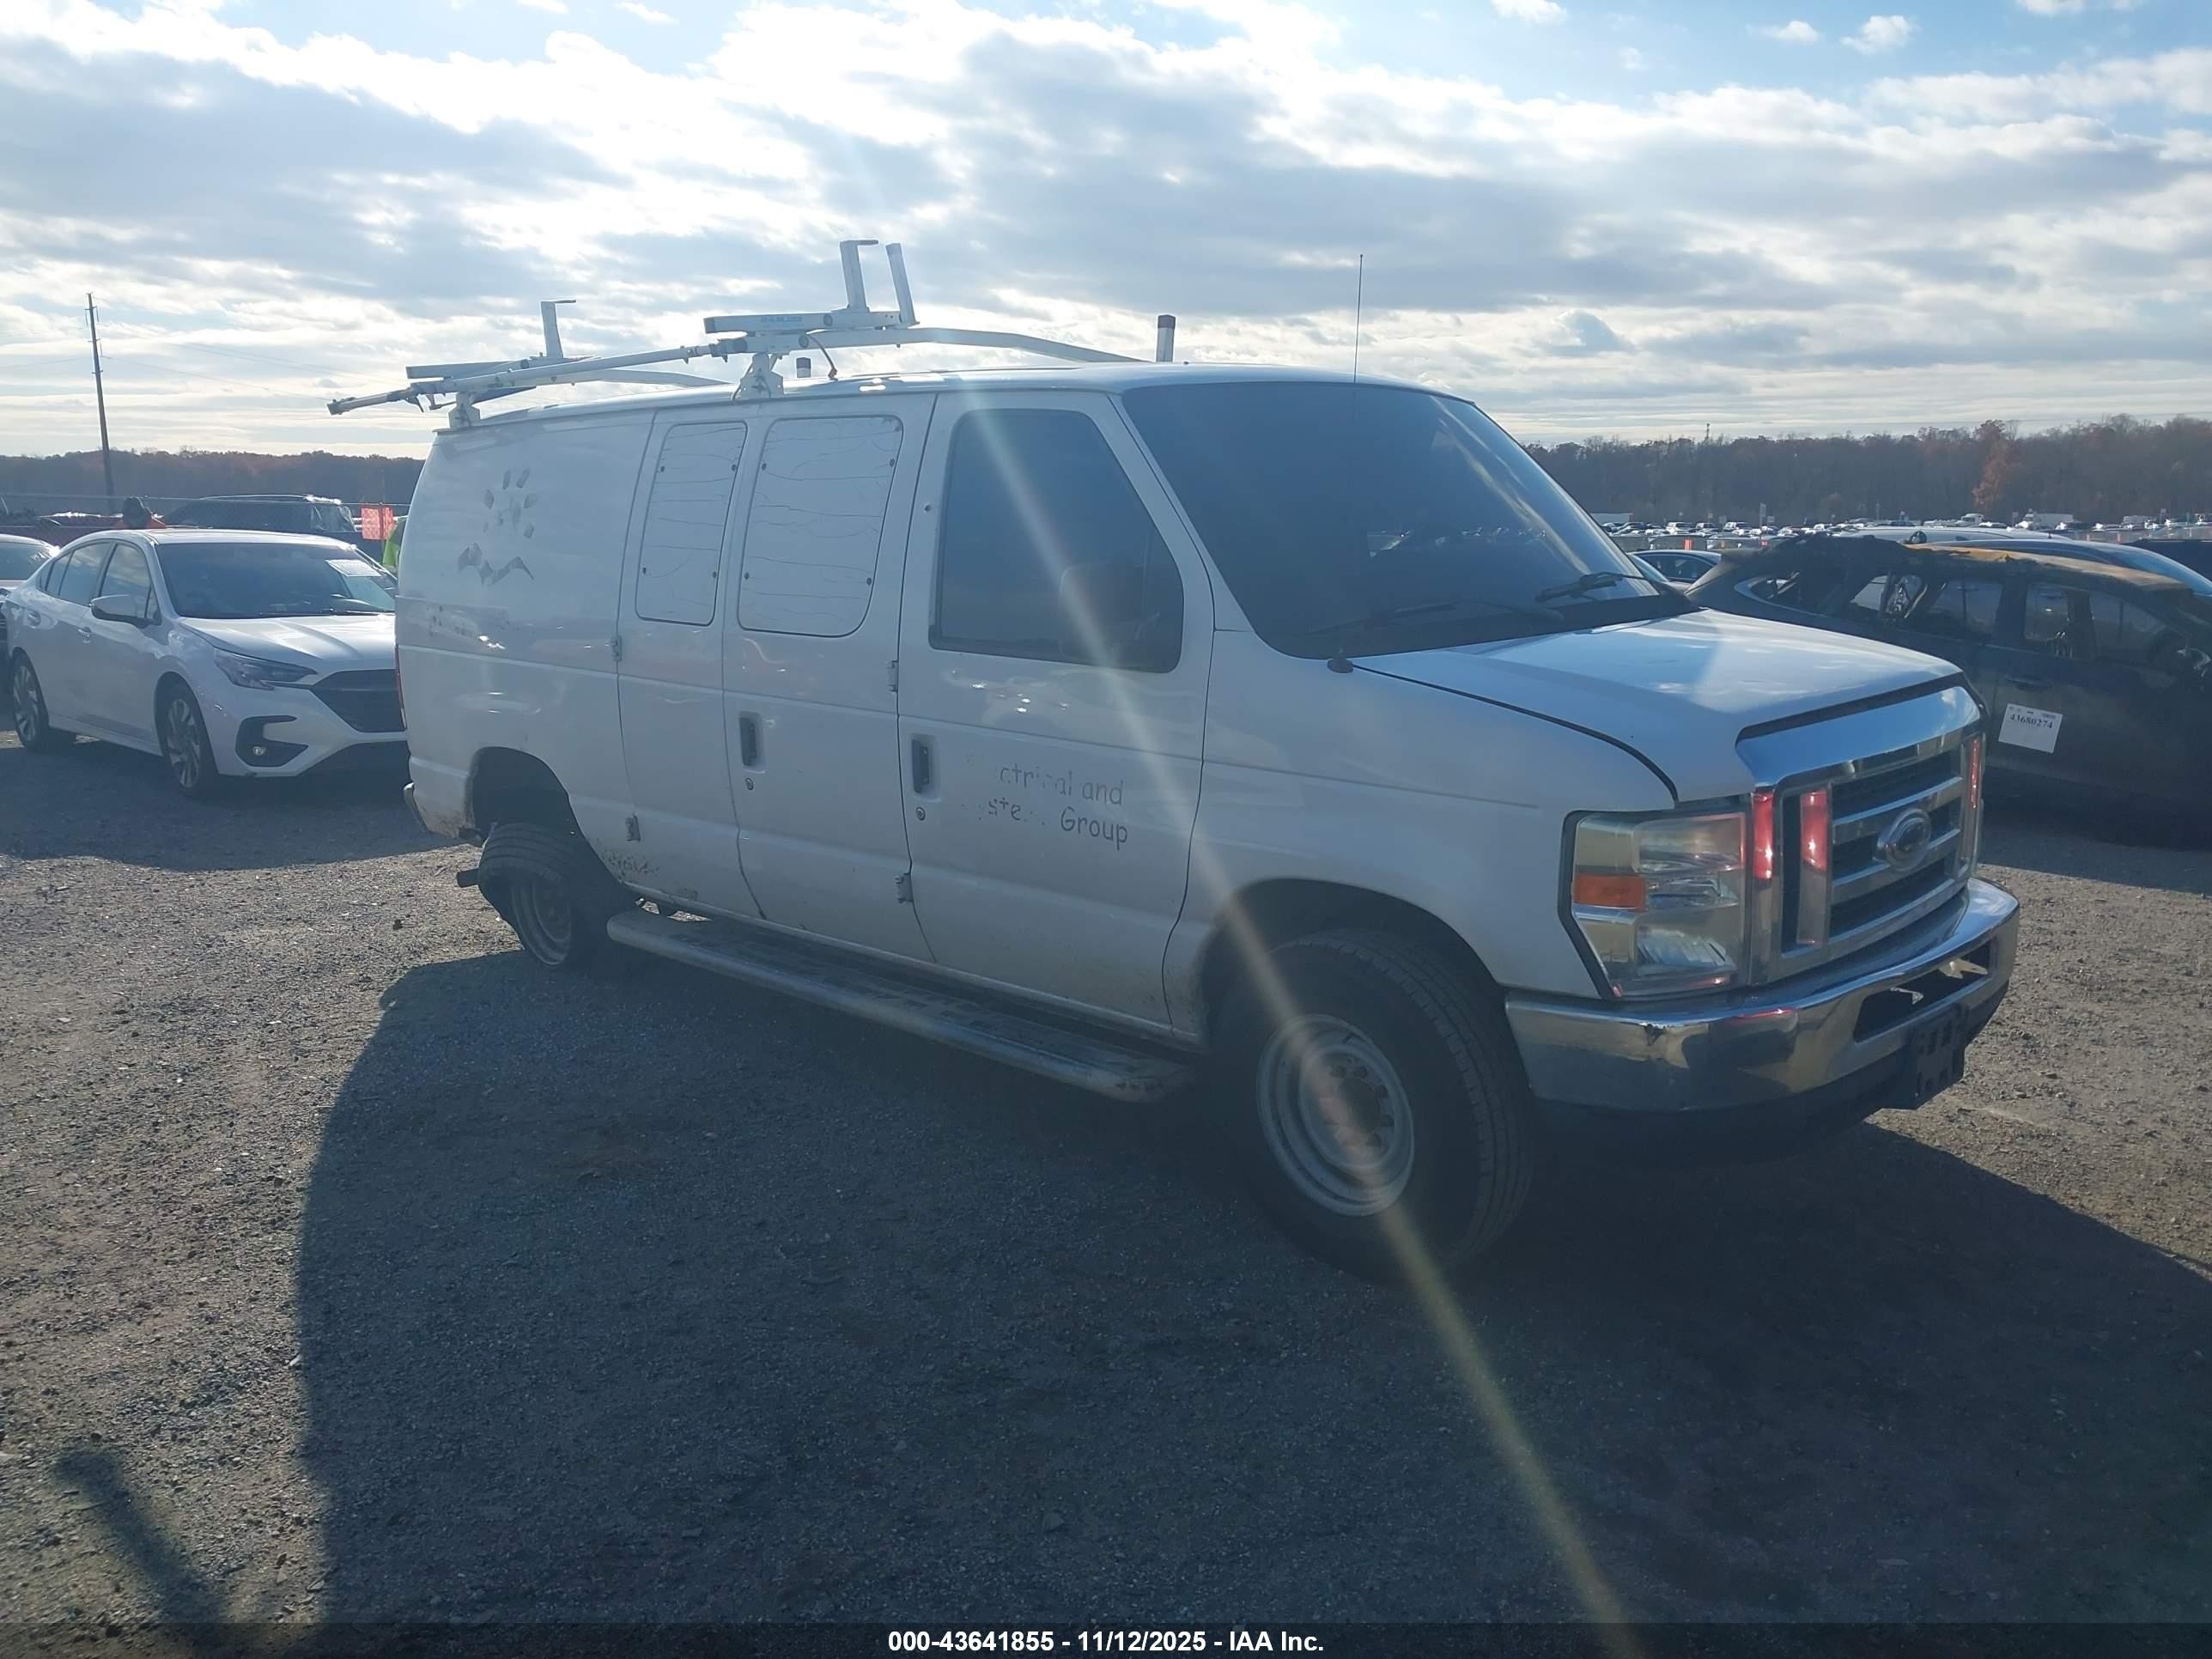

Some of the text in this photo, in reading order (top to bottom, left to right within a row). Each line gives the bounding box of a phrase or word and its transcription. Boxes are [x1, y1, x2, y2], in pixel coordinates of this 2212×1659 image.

[2010, 714, 2053, 729] 43680274
[1081, 778, 1125, 805] and
[1060, 806, 1128, 851] Group
